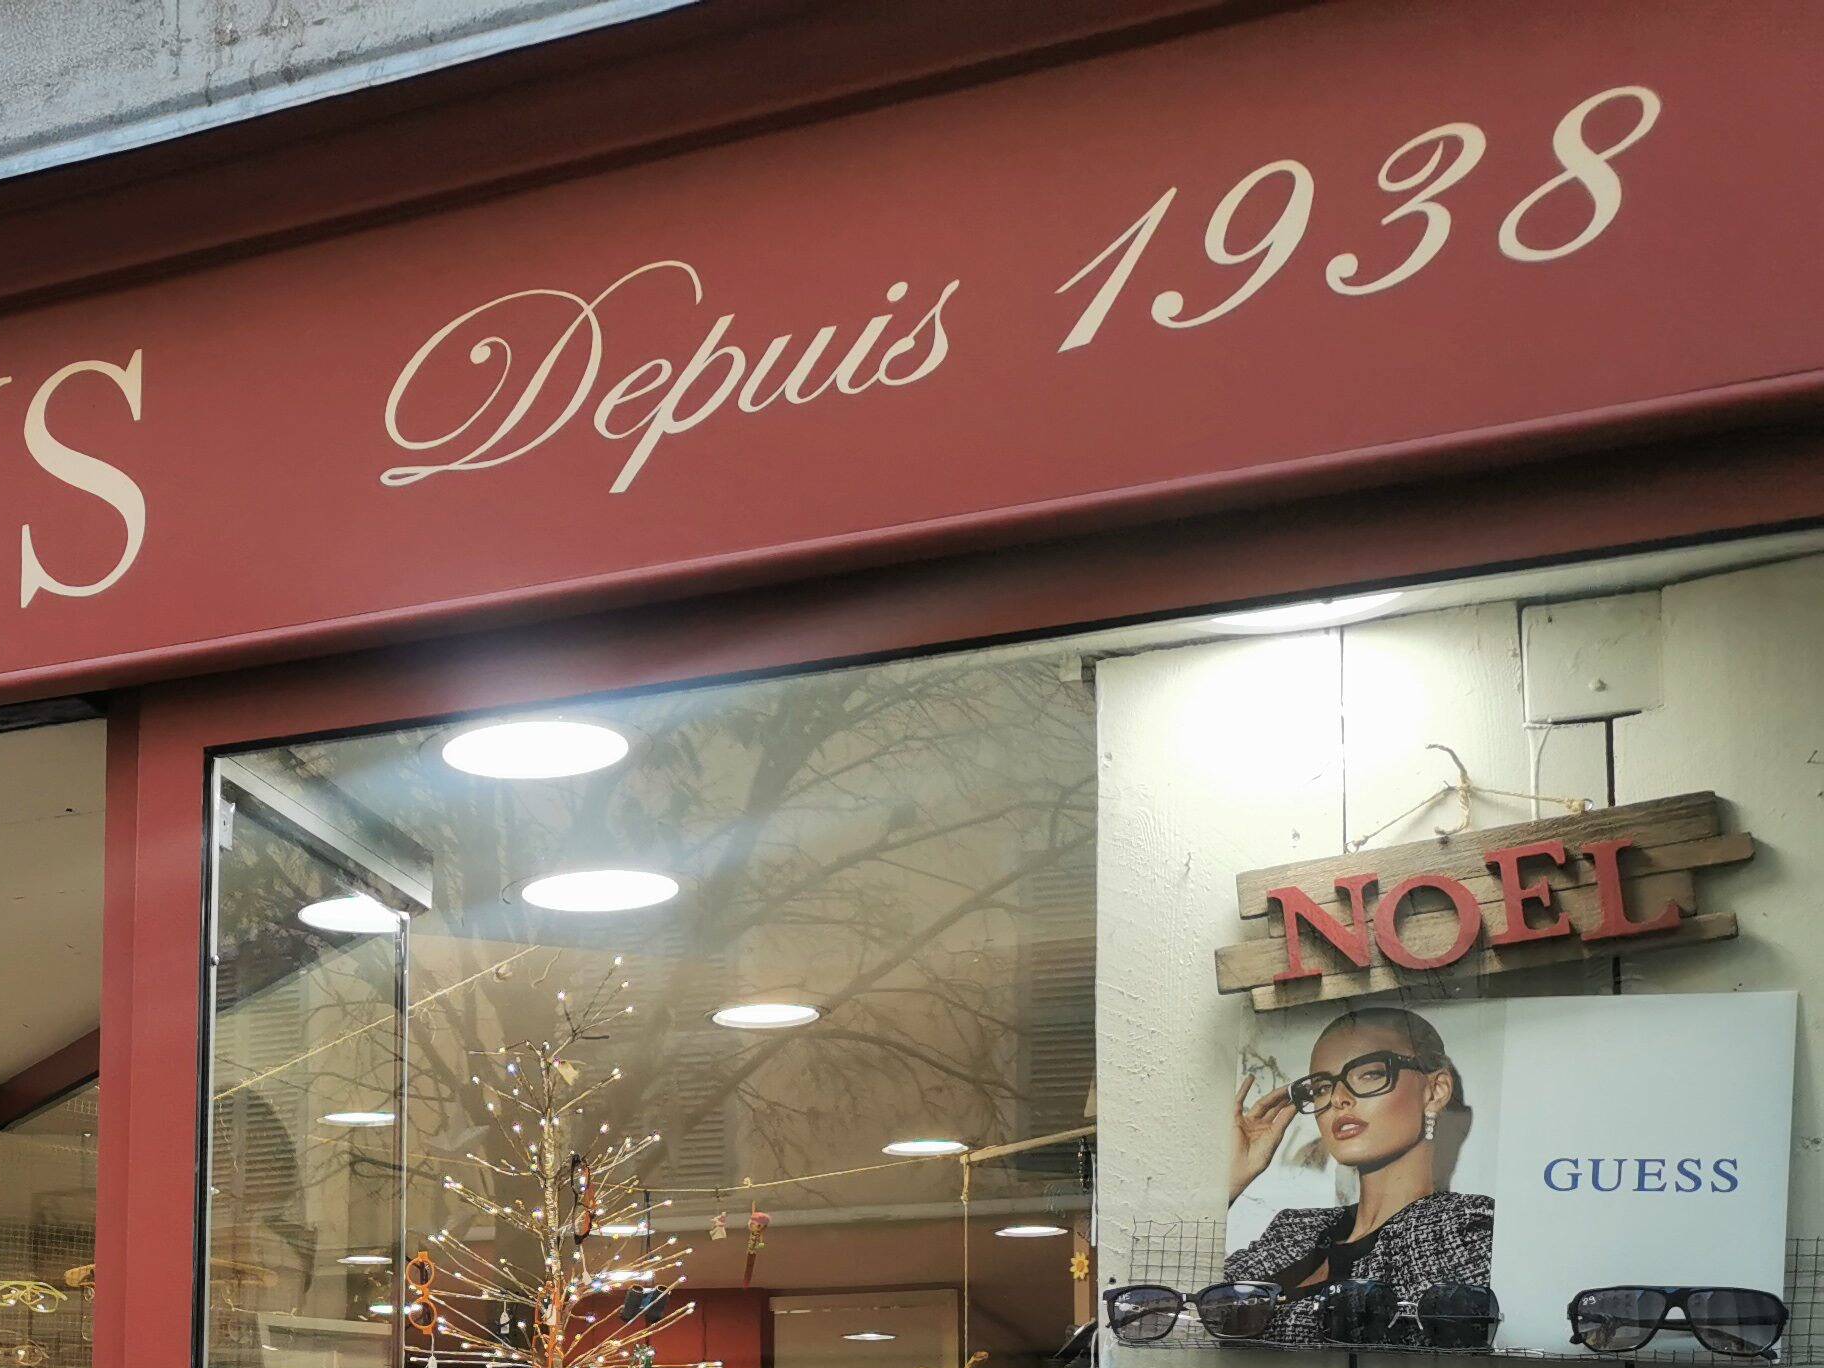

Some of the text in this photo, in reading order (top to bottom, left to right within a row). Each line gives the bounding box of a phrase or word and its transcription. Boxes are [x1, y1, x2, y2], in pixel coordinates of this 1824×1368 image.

[379, 260, 960, 494] Depuis
[1054, 85, 1662, 354] 1938
[1267, 838, 1681, 982] NOEL
[1543, 1157, 1740, 1194] GUESS
